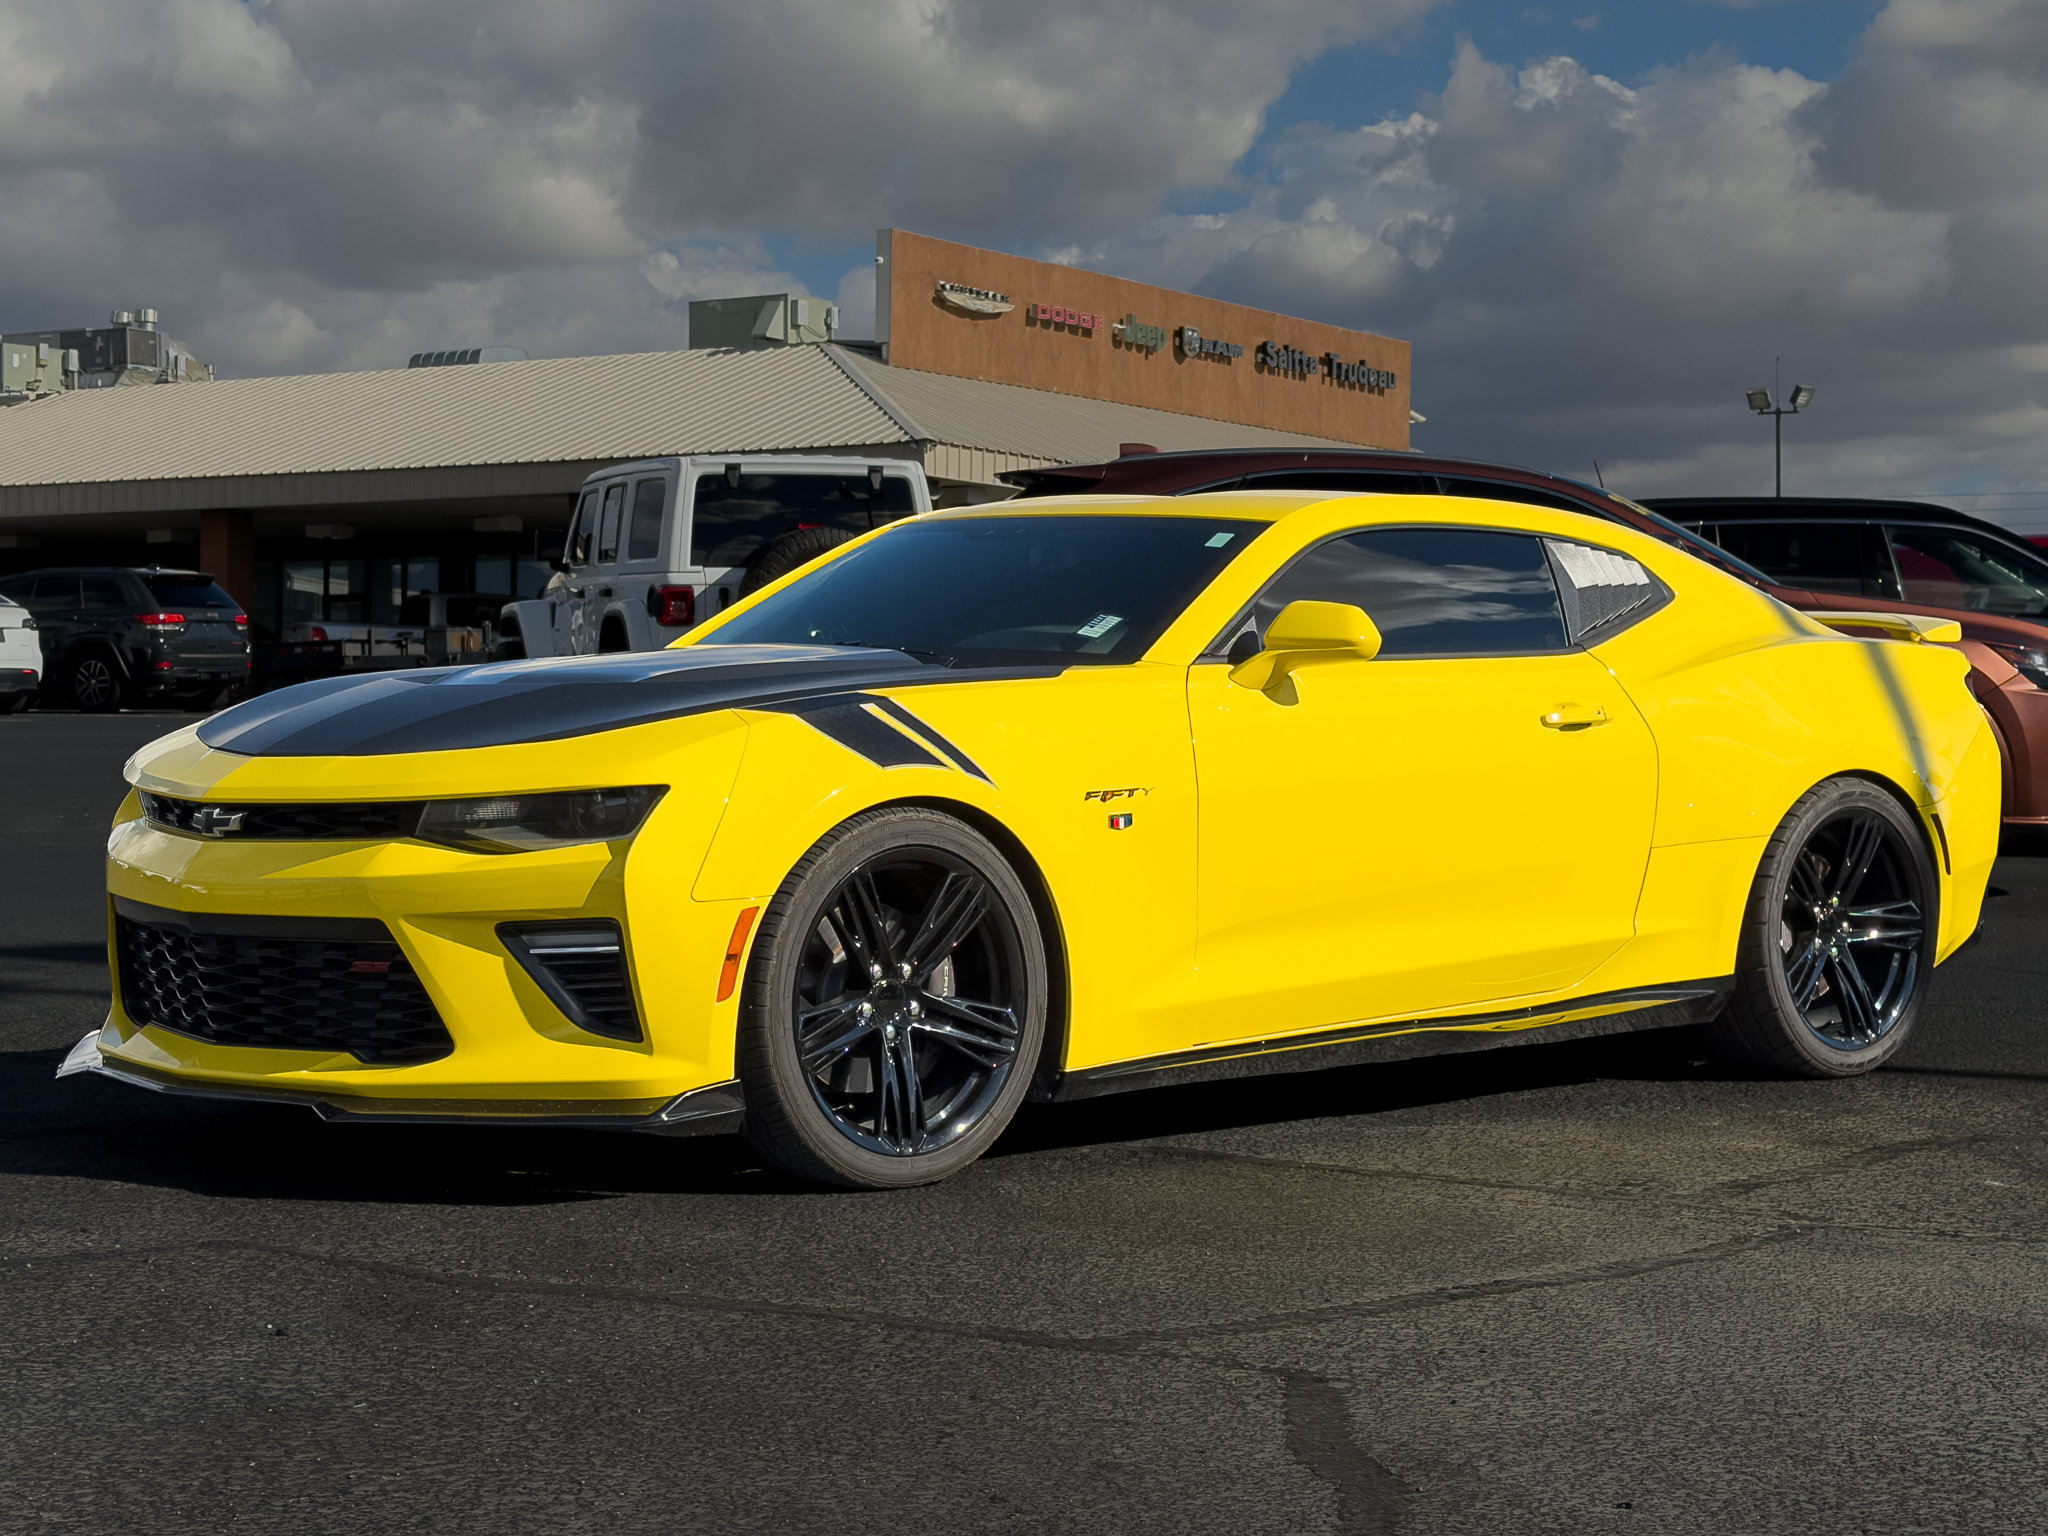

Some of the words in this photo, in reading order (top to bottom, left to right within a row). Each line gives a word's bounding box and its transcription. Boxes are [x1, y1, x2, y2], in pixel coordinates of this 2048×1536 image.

[1036, 304, 1104, 330] DODGE
[1124, 314, 1167, 352] Jeep
[1201, 338, 1244, 358] RAM
[1265, 340, 1319, 374] Saitta
[1326, 352, 1397, 389] Trudeau
[1084, 787, 1156, 803] FIFTY
